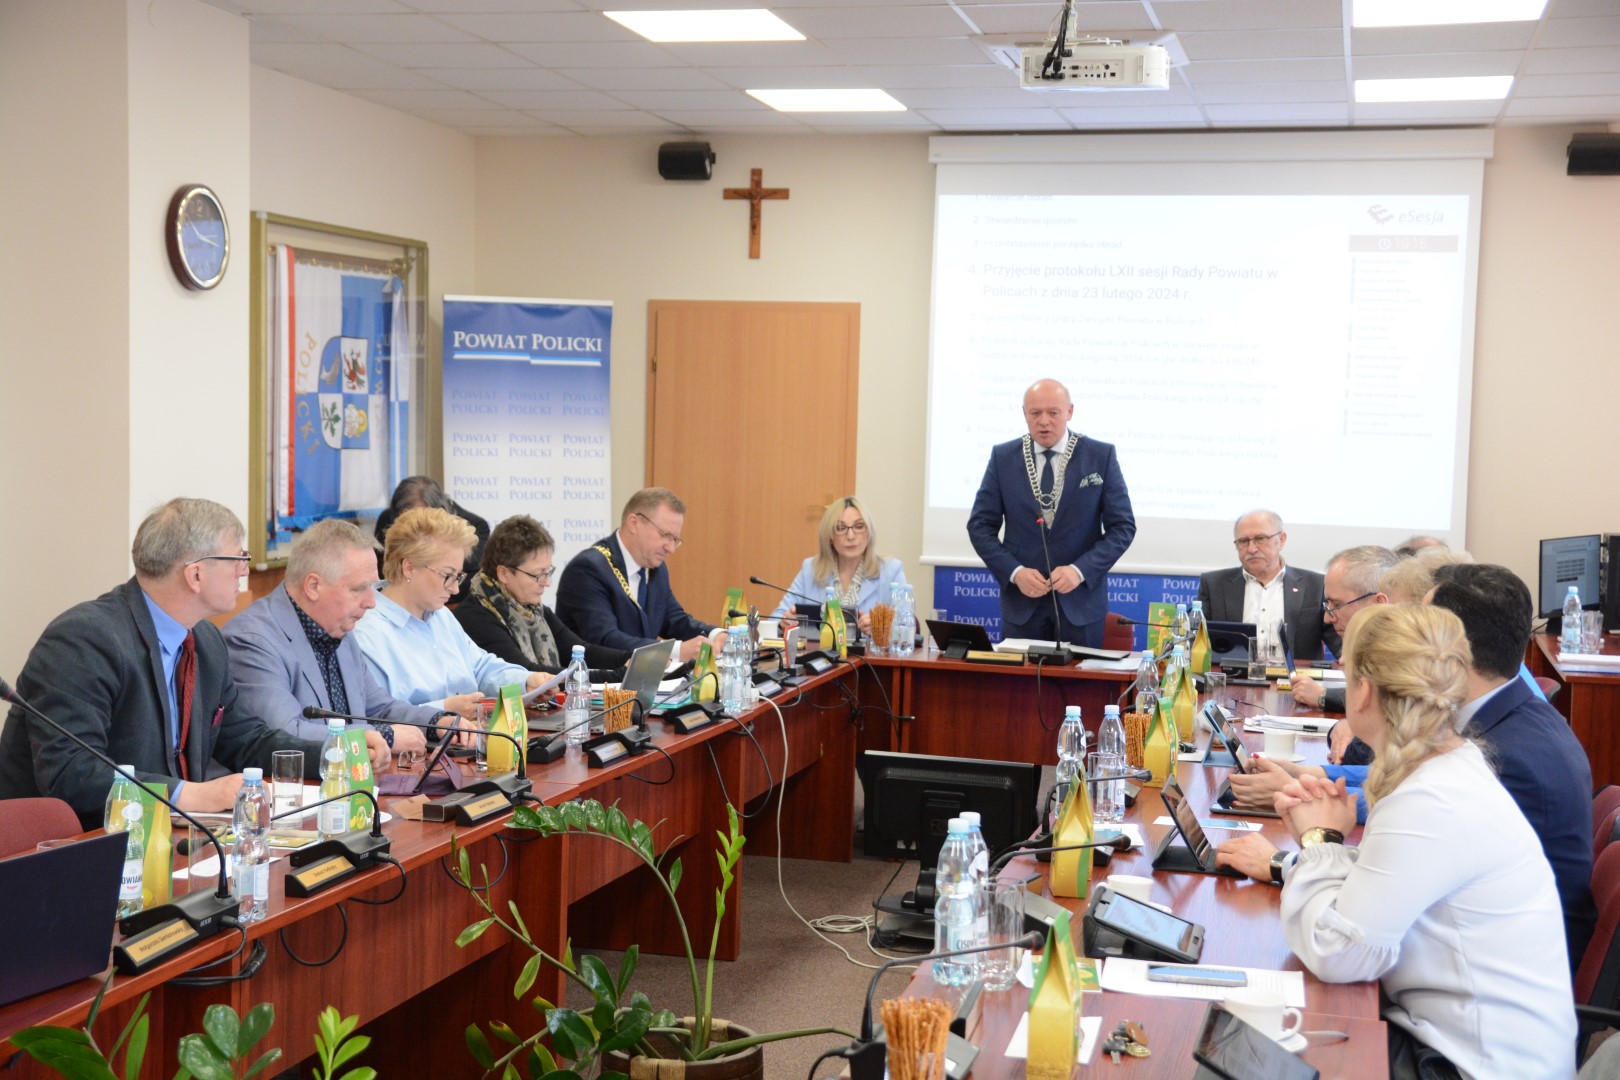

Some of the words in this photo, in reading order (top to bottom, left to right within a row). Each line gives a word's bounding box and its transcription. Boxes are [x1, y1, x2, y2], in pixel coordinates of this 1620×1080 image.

[1398, 209, 1444, 225] eSesja
[984, 264, 1041, 279] Przyjęcie
[1044, 264, 1106, 278] protokołu
[1109, 265, 1135, 277] LXII
[1138, 265, 1168, 280] sesji
[1172, 265, 1205, 281] Rady
[1208, 265, 1263, 279] Powiatu
[1267, 269, 1279, 279] w
[983, 285, 1038, 298] Policach
[1041, 288, 1049, 298] z
[1051, 285, 1080, 299] dnia
[1082, 286, 1099, 299] 23
[1102, 287, 1143, 303] lutego
[1146, 287, 1181, 300] 2024
[453, 331, 527, 349] POWIAT
[532, 333, 603, 352] POLICKI
[452, 432, 498, 443] POWIAT
[509, 433, 552, 444] POWIAT
[563, 434, 605, 444] POWIAT
[452, 447, 499, 457] POLICKI
[509, 447, 552, 457] POLICKI
[563, 448, 605, 458] POLICKI
[453, 476, 498, 486] POWIAT
[509, 476, 552, 486] POWIAT
[563, 476, 605, 486] POWIAT
[453, 490, 499, 500] POLICKI
[509, 490, 552, 500] POLICKI
[563, 490, 605, 500] POLICKI
[563, 518, 605, 528] POWIAT
[954, 571, 995, 583] POWIA
[1107, 577, 1139, 589] WIAT
[1107, 592, 1139, 603] LICKI
[1162, 592, 1197, 605] POLIC
